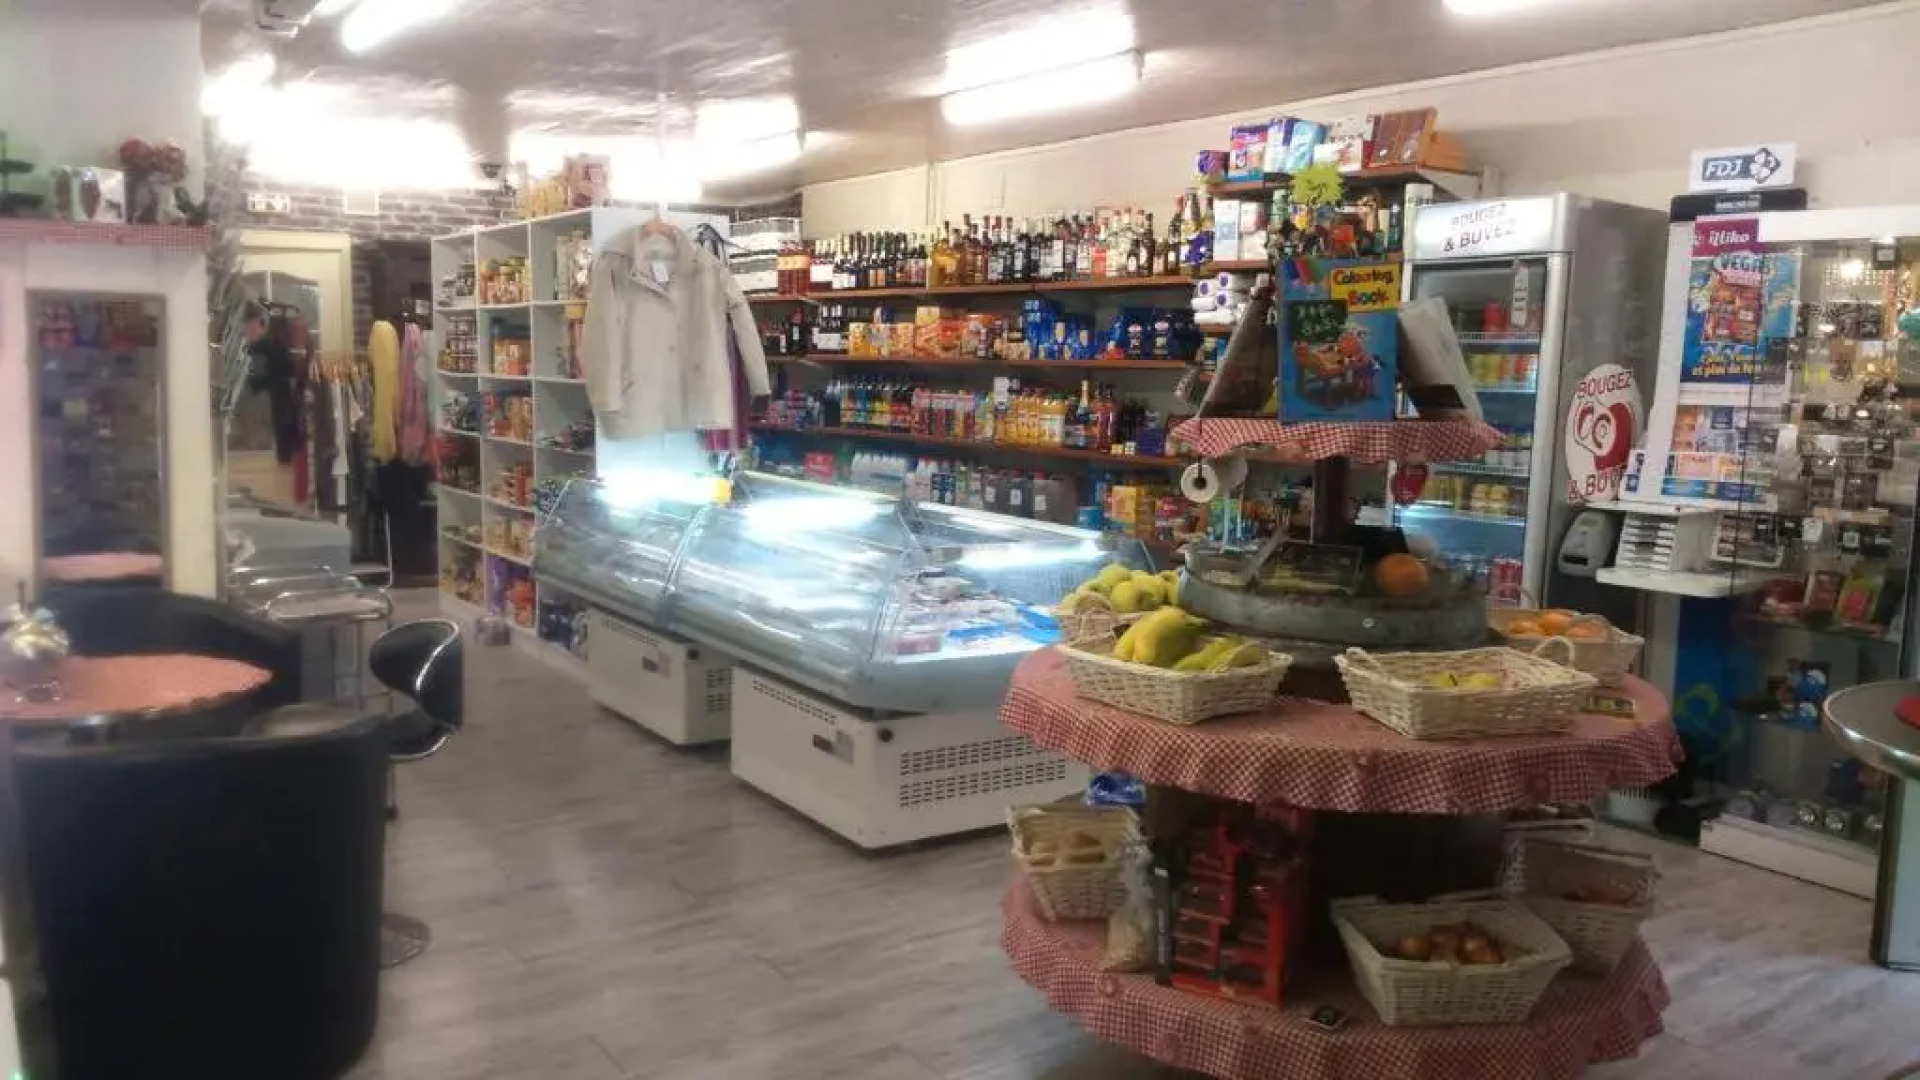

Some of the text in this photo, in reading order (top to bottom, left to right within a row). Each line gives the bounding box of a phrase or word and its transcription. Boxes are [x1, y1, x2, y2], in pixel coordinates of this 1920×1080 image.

[1705, 159, 1742, 178] FDJ
[1451, 202, 1508, 226] BOUGEZ
[1443, 237, 1455, 252] &
[1347, 287, 1390, 307] Book
[1575, 370, 1632, 399] BOUGEZ
